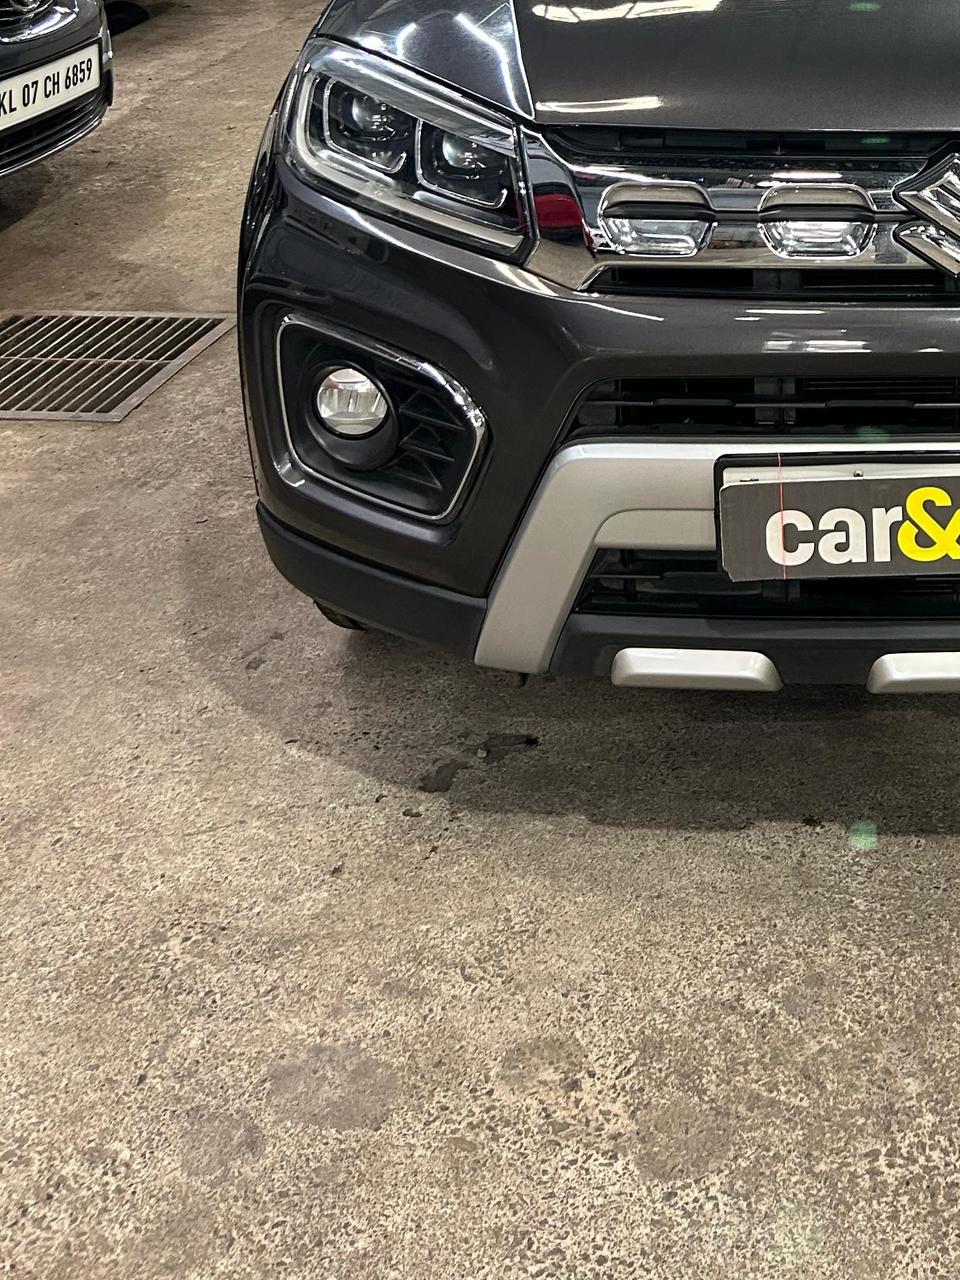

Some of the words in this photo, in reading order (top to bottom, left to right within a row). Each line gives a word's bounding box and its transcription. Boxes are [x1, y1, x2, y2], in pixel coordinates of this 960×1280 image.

[0, 89, 17, 117] KL
[22, 79, 39, 108] 07
[44, 71, 60, 98] CH
[65, 58, 93, 90] 6859
